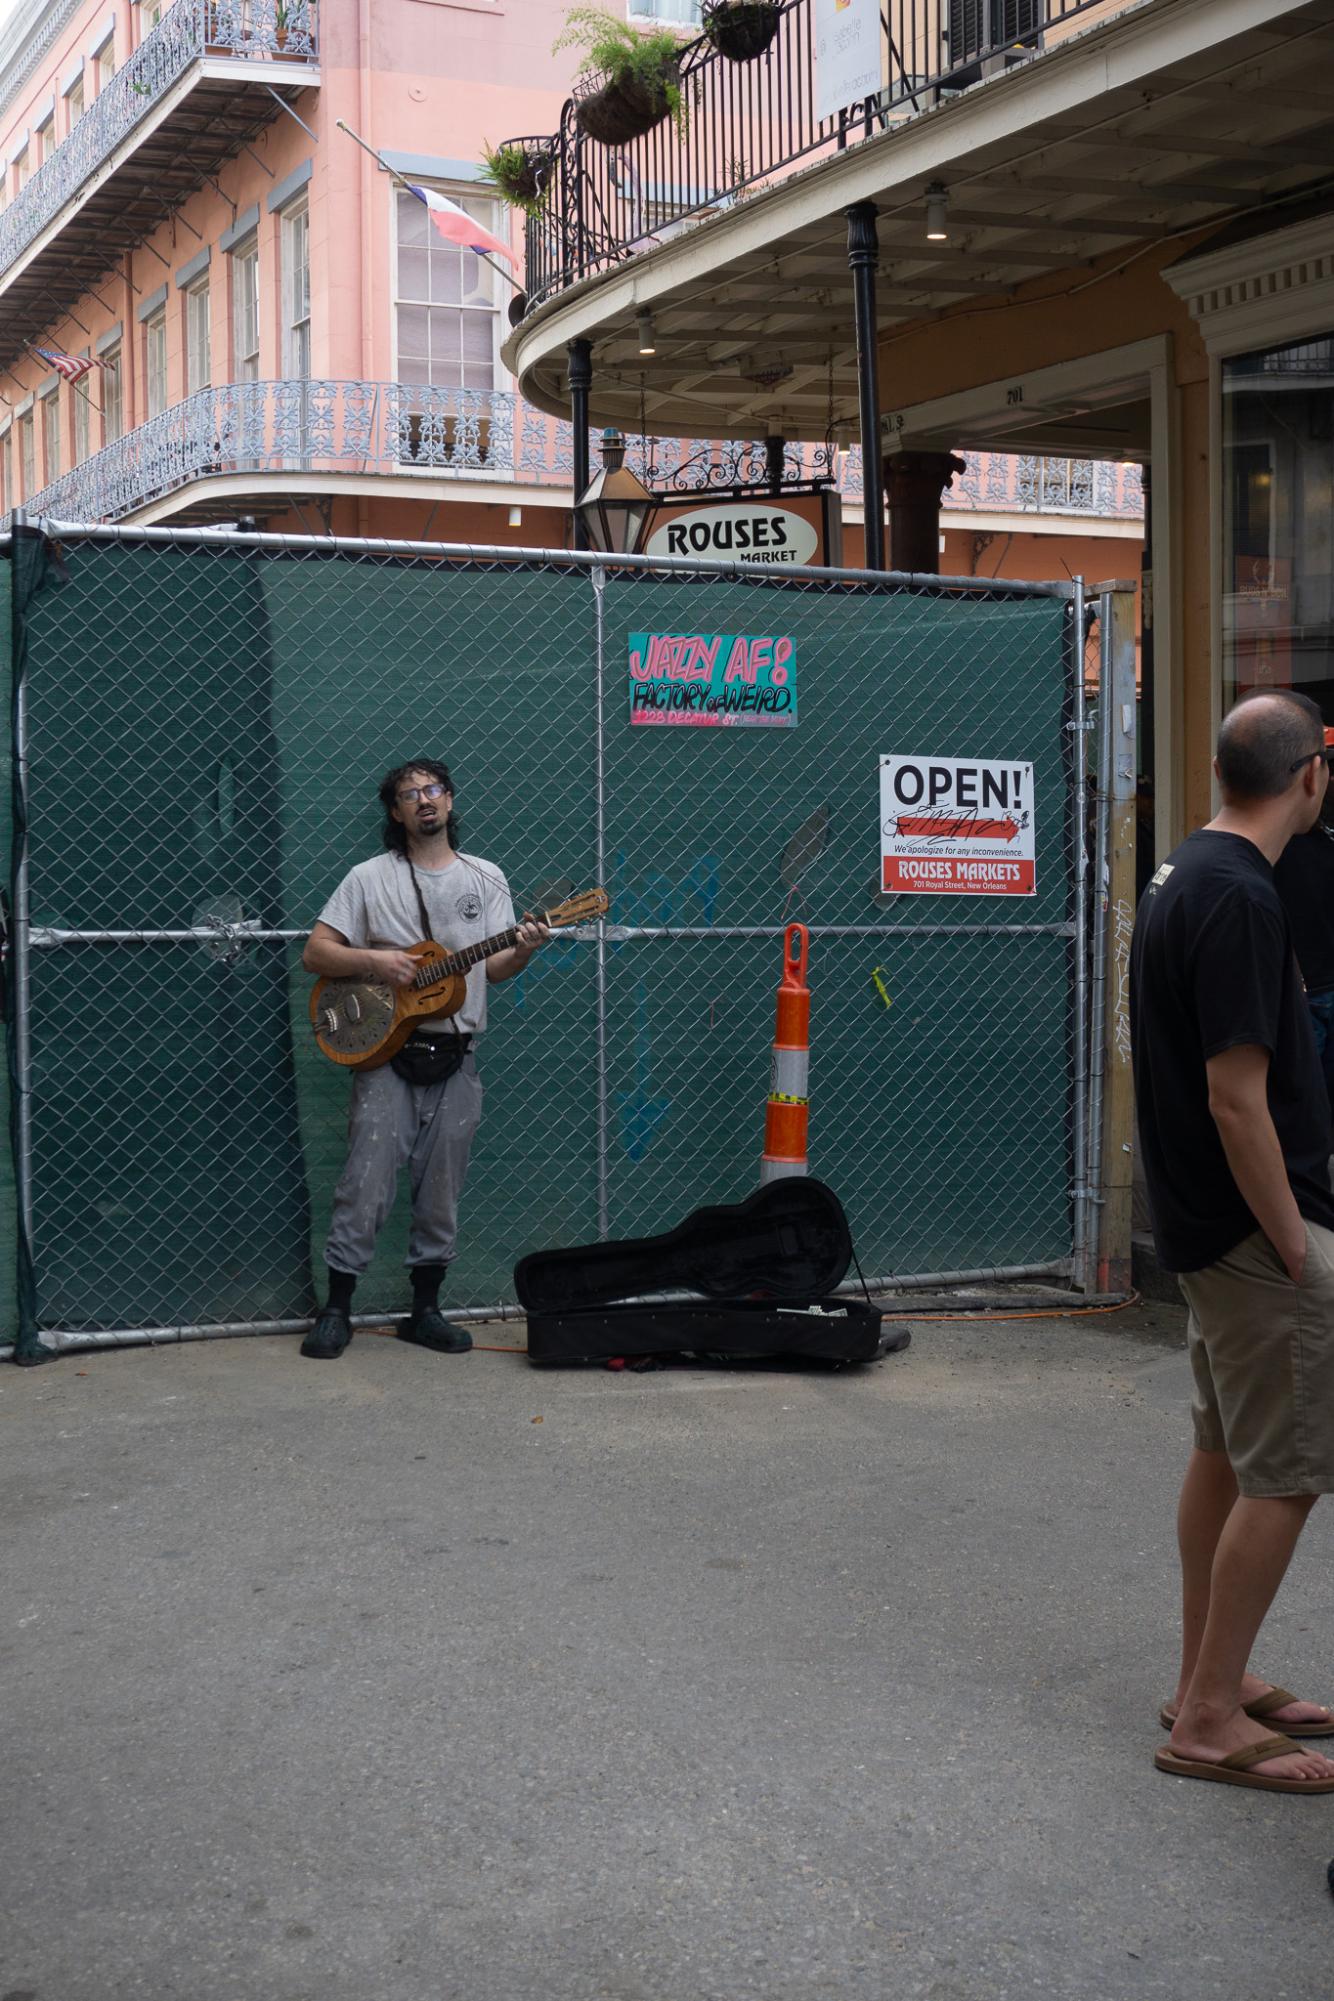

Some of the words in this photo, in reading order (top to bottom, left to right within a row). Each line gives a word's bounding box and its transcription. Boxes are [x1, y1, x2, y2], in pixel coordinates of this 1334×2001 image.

[667, 516, 787, 556] ROUSES
[740, 550, 797, 564] MARKET
[630, 635, 721, 682] JAZZY
[722, 637, 792, 685] AF!
[633, 683, 711, 711] FACTORY
[894, 765, 1022, 809] OPEN!
[894, 845, 907, 853] We
[908, 846, 944, 857] apologize
[945, 846, 956, 855] for
[957, 848, 973, 857] any
[972, 848, 1024, 857] inconvenience.
[898, 860, 953, 880] ROUSES
[956, 862, 1021, 881] MARKETS
[913, 880, 925, 888] 701
[925, 880, 944, 890] Royal
[944, 881, 966, 890] Street,
[982, 882, 1007, 890] Orleans
